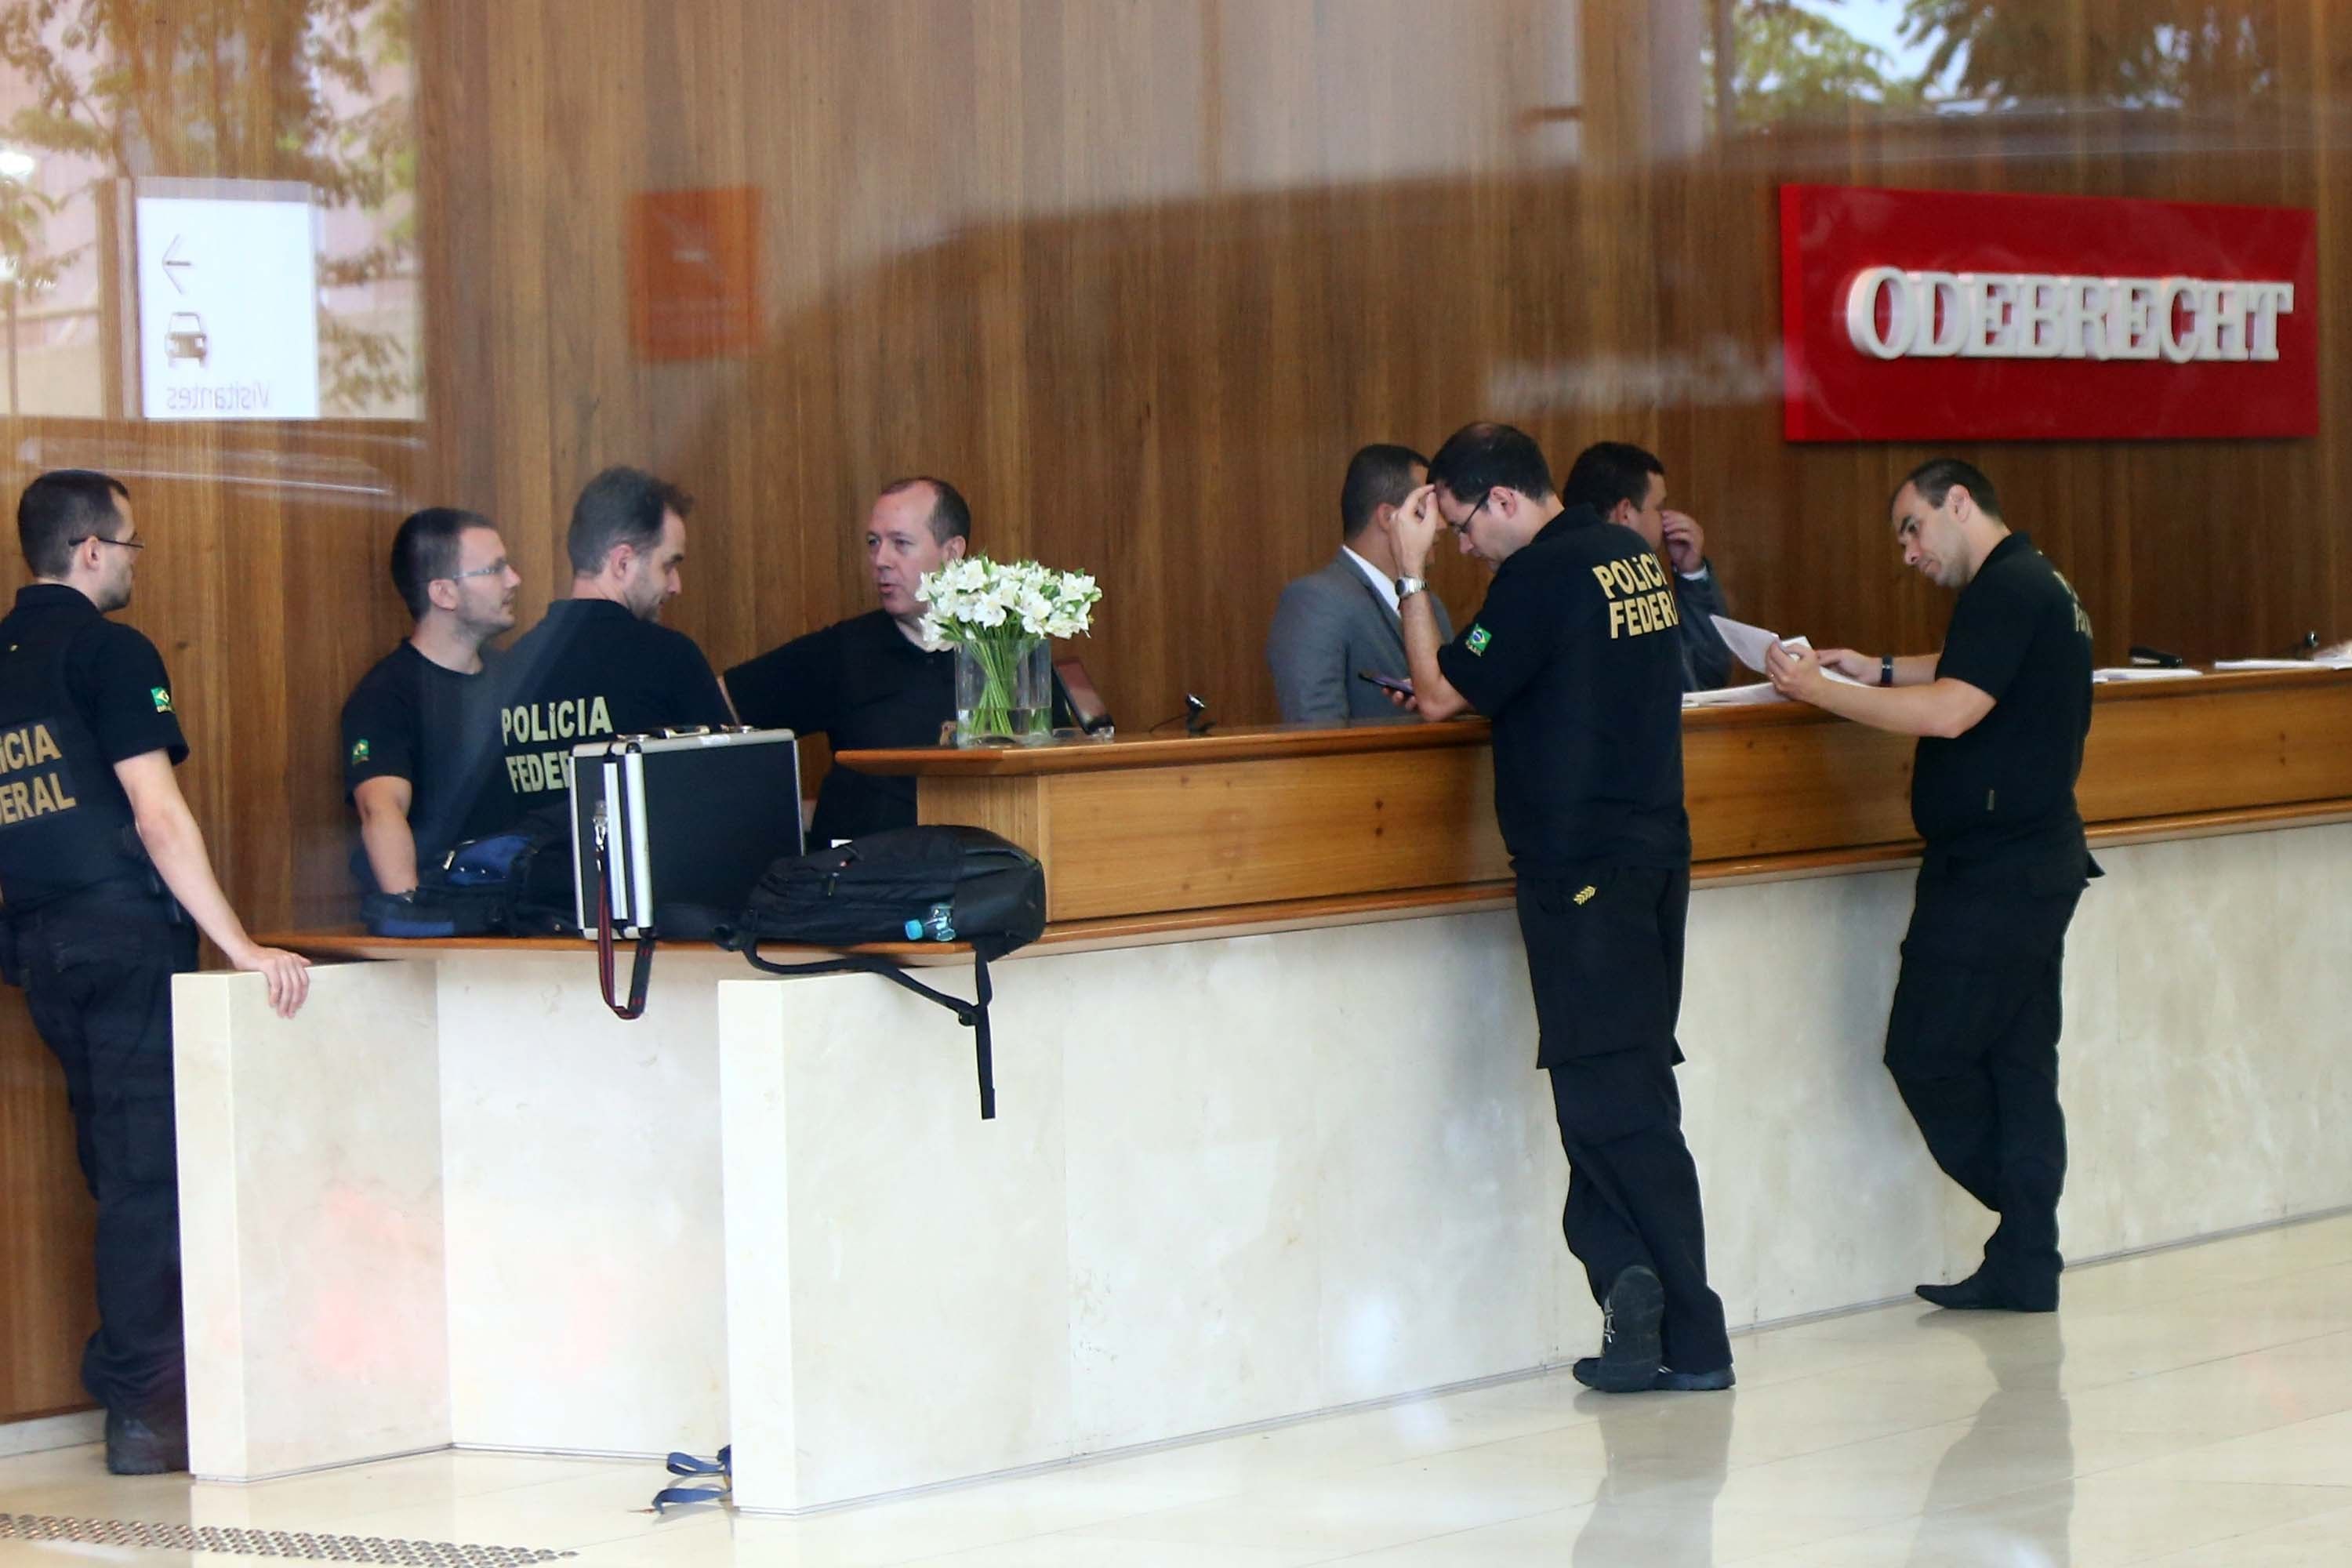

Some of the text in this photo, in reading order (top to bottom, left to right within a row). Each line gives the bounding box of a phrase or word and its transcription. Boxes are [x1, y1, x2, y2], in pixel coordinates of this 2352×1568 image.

[1846, 266, 2295, 364] ODEBRECHT
[1609, 590, 1679, 639] FEDER
[0, 773, 76, 825] ERAL
